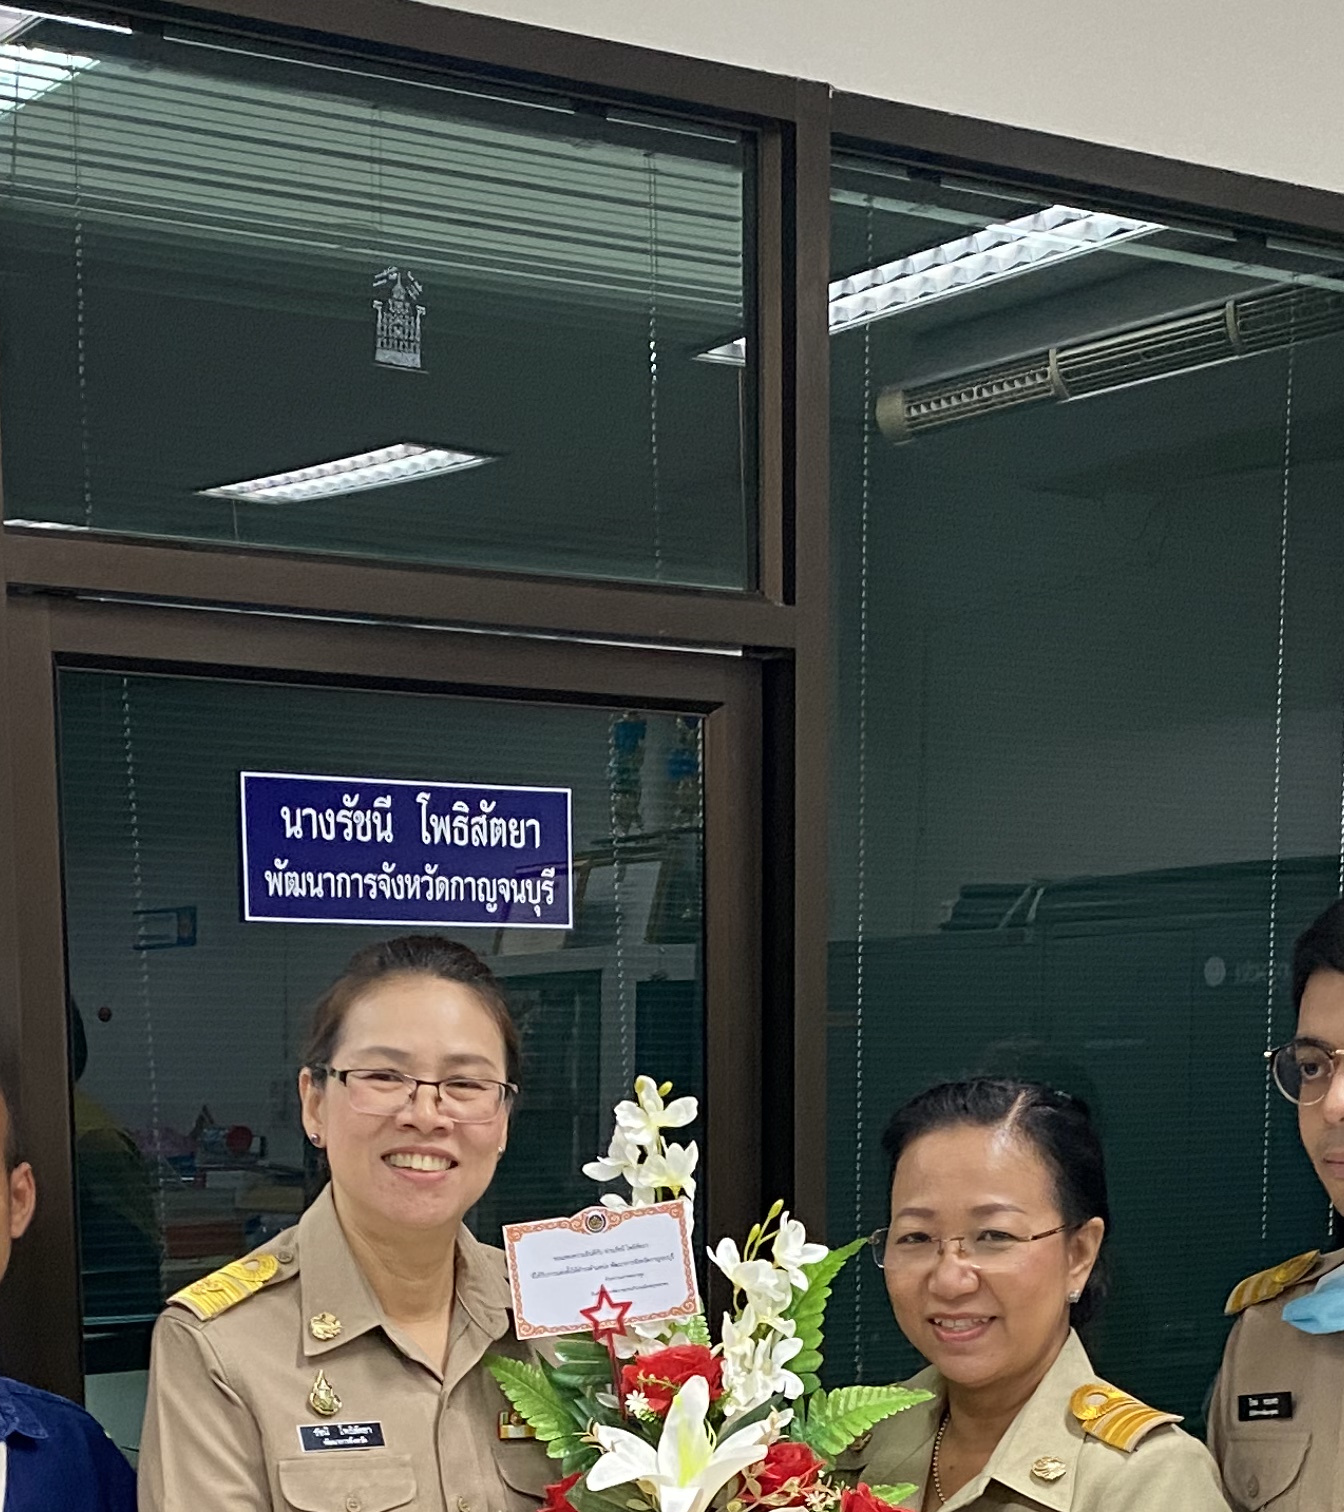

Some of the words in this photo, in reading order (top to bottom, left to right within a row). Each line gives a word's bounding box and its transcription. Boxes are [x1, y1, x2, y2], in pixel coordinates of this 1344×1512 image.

[281, 793, 394, 843] นางรัชนี
[416, 792, 541, 849] โพธิสัตยา
[264, 858, 555, 917] พัฒนาการจังหวัดกาญจนบุรี
